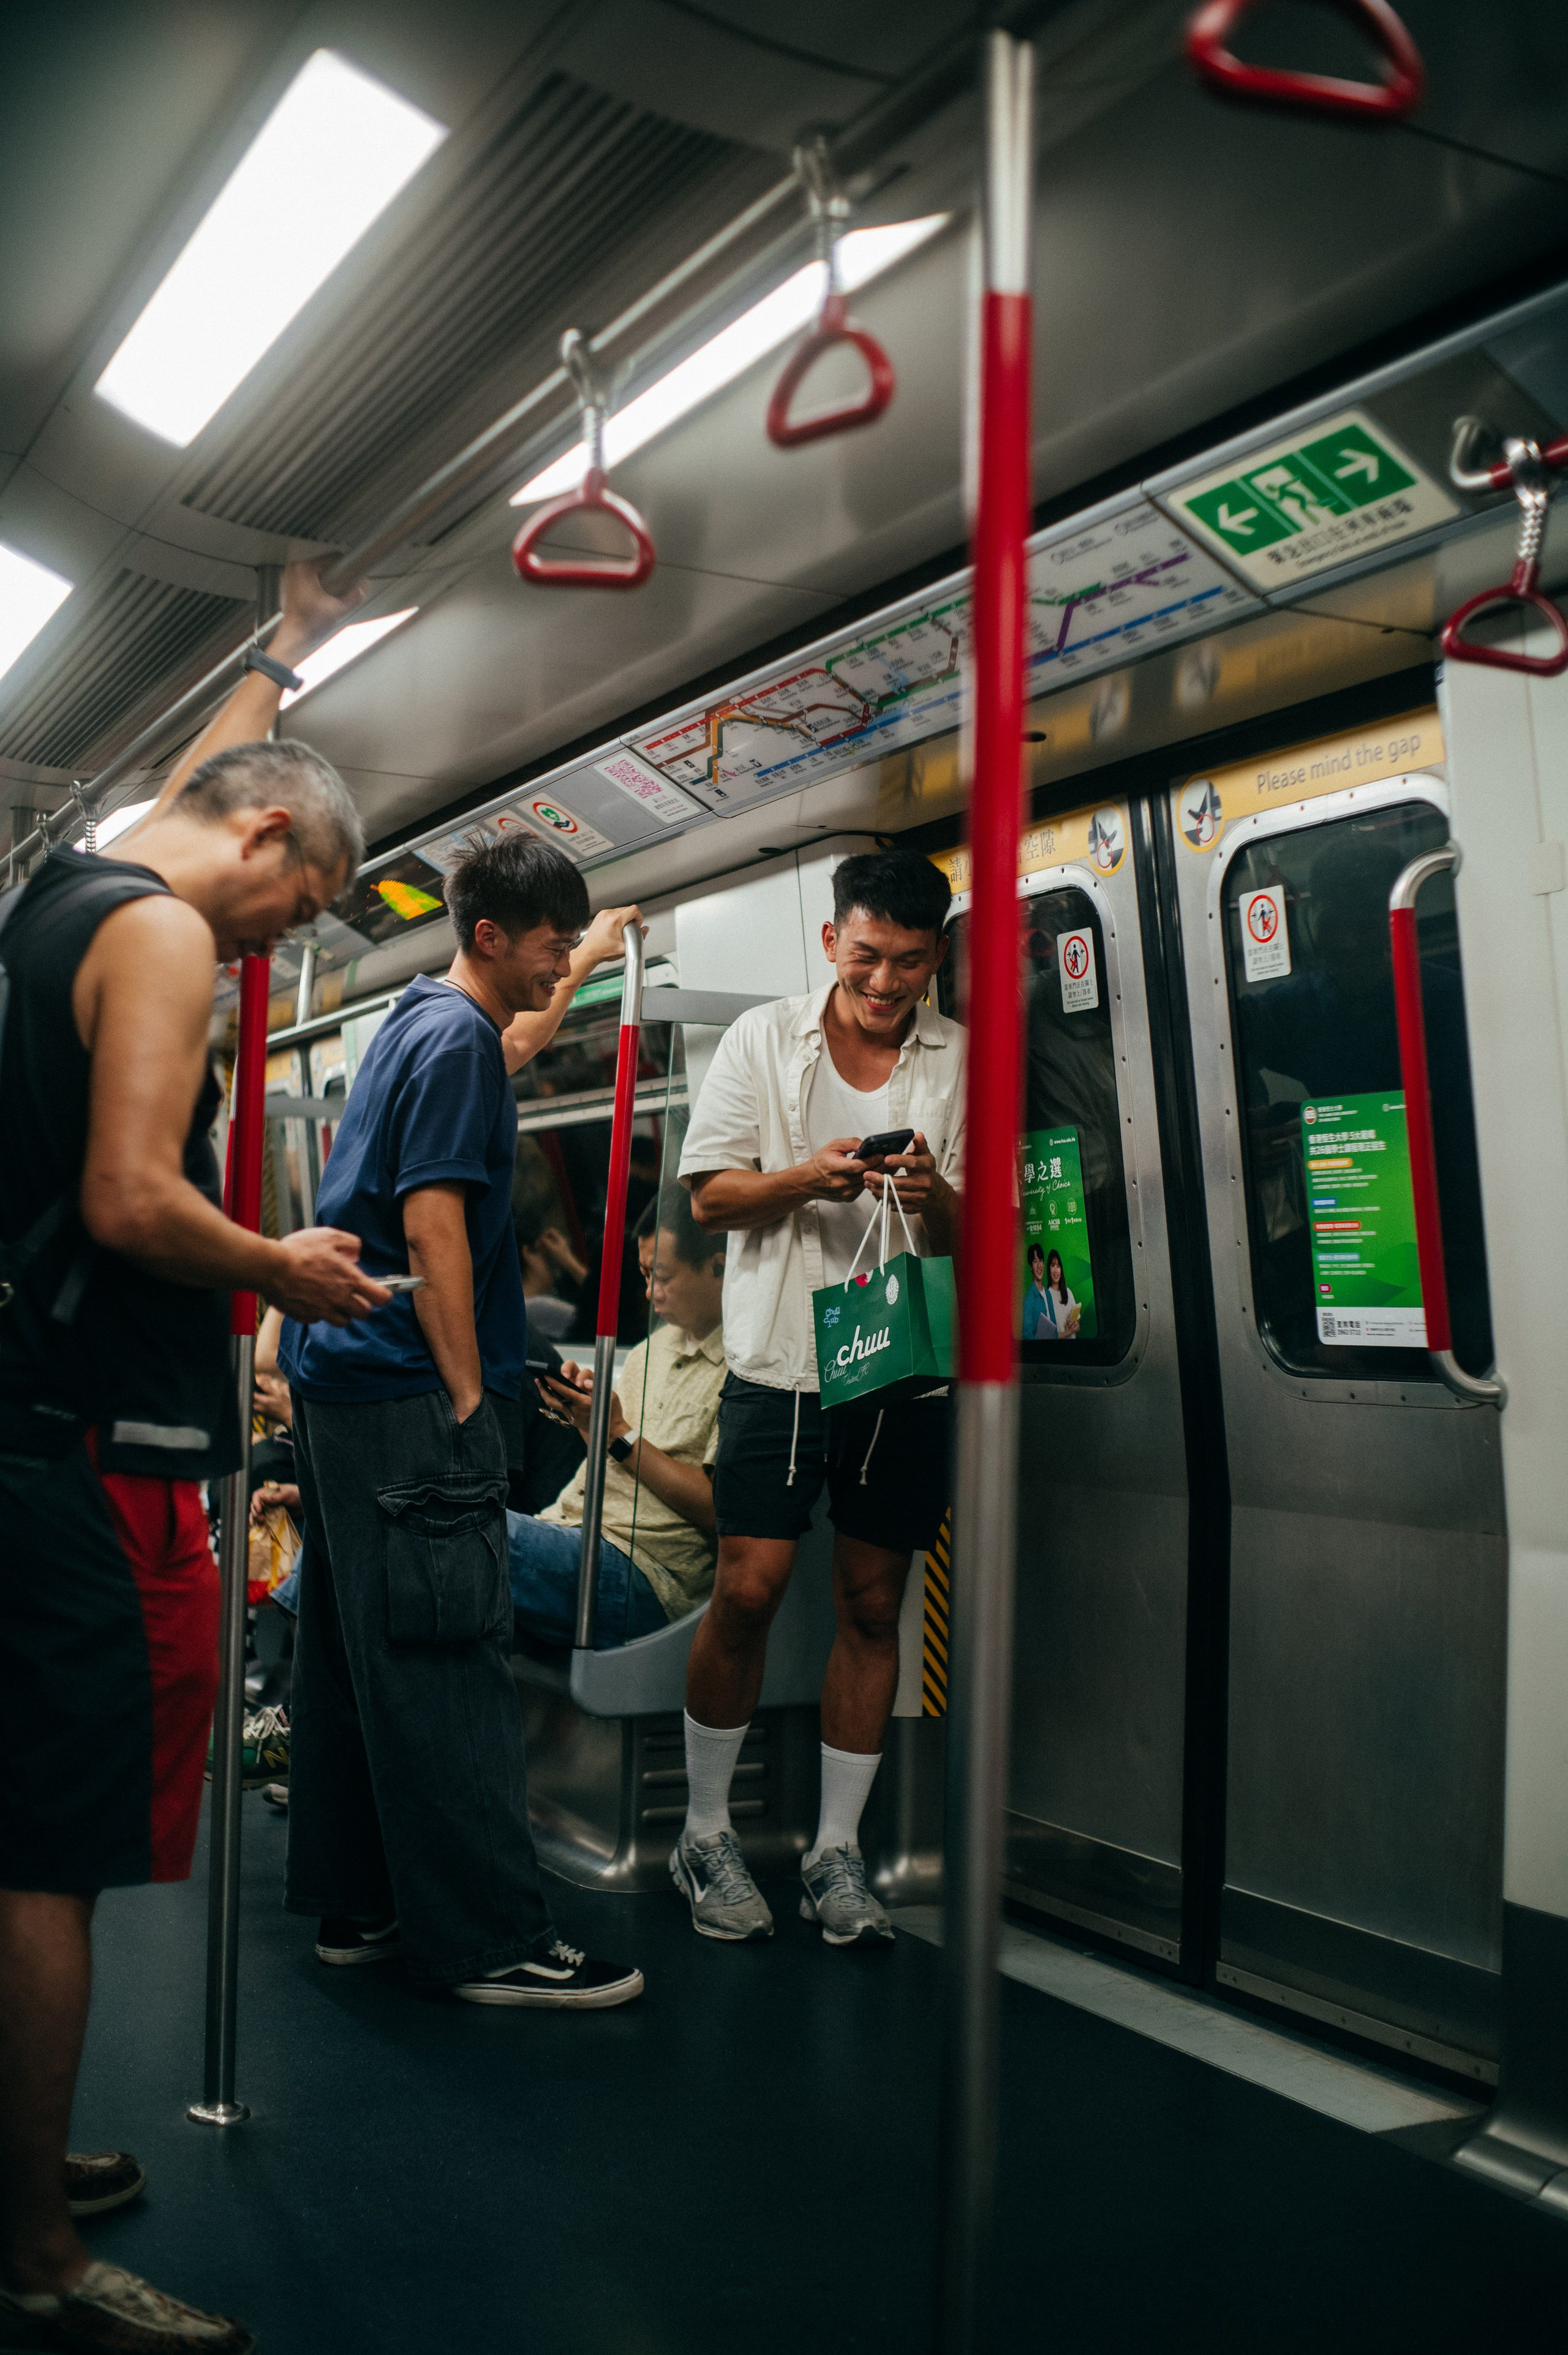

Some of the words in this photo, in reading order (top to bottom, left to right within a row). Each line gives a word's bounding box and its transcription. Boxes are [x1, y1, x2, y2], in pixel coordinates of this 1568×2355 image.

[1257, 768, 1306, 795] Please
[1311, 749, 1351, 779] mind
[1356, 744, 1383, 767] the
[1389, 734, 1421, 763] gap
[949, 829, 1057, 883] 請小空隙
[1018, 1157, 1062, 1184] 學之選
[1046, 1183, 1051, 1194] of
[1052, 1179, 1071, 1191] Choice
[837, 1325, 891, 1367] chuu
